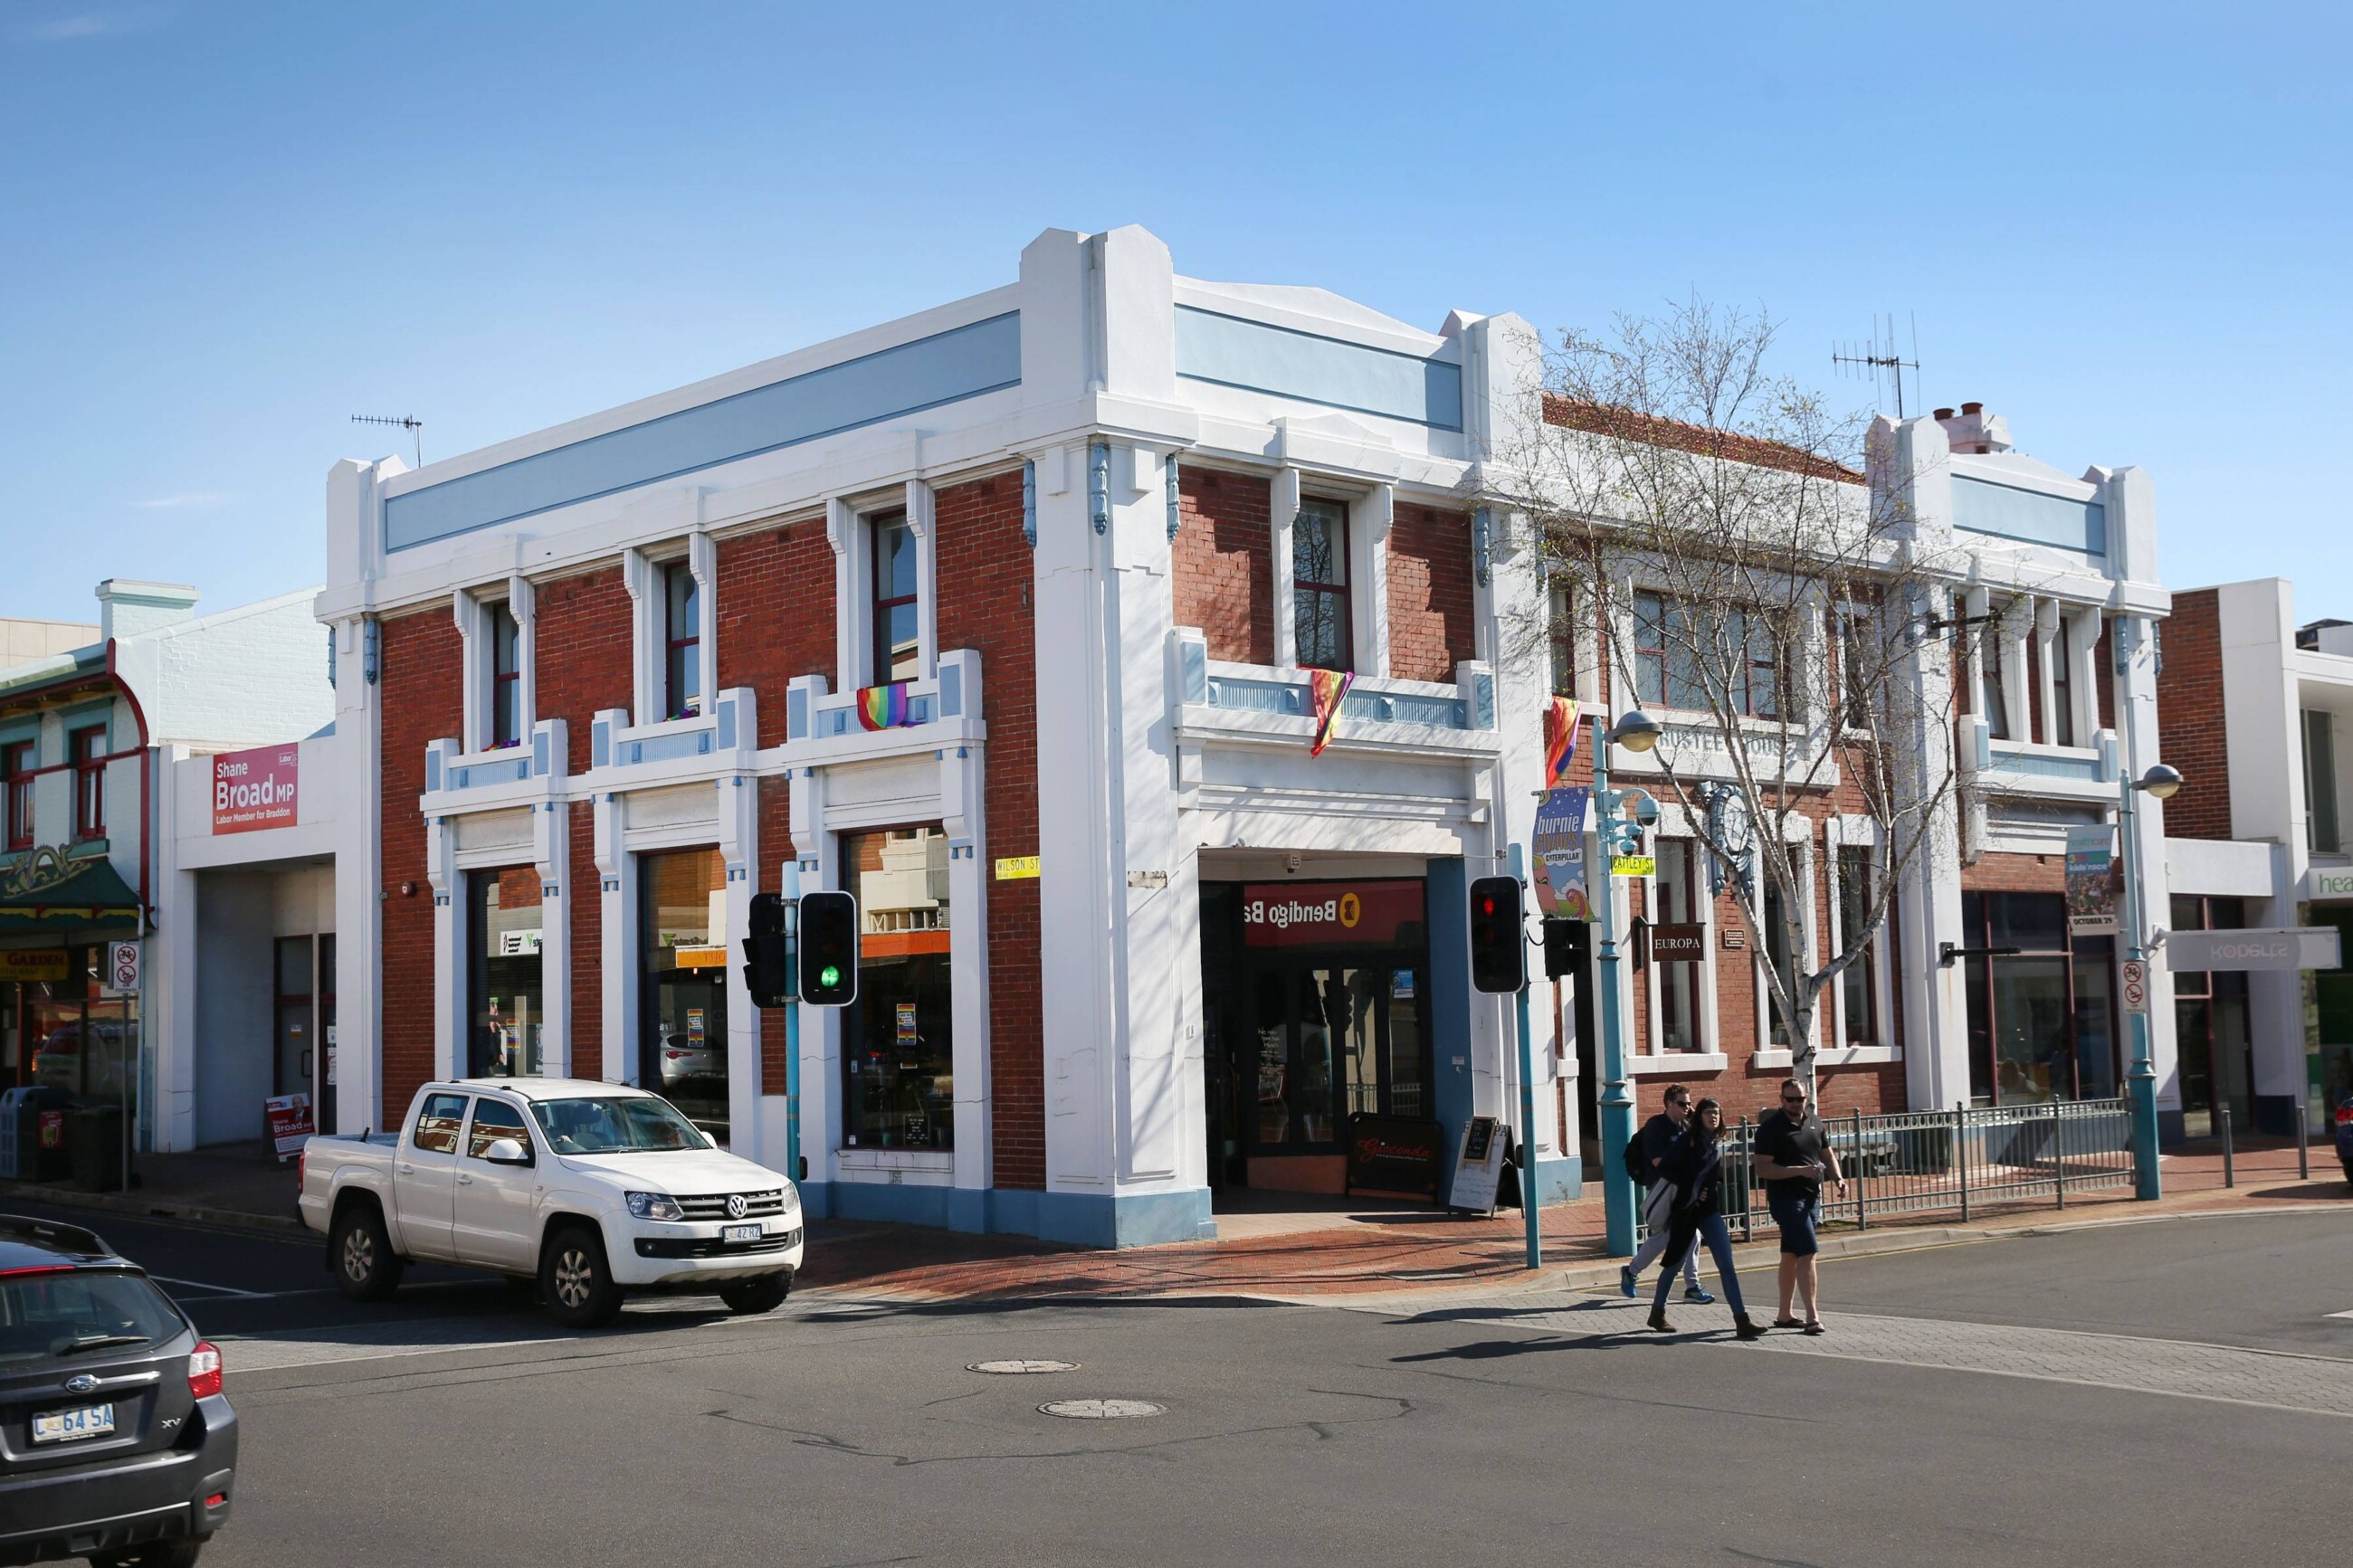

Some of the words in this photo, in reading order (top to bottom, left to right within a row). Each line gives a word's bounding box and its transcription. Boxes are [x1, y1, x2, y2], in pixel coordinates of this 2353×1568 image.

[1655, 728, 1723, 752] RUSTEE
[217, 762, 248, 778] Shane
[216, 774, 273, 811] Broad
[276, 784, 294, 803] MP
[216, 816, 232, 824] Labor
[233, 812, 255, 822] Member
[266, 808, 290, 818] Braddon
[1538, 815, 1579, 834] burnie
[1545, 852, 1580, 862] CATERPILLAR
[1613, 857, 1642, 870] CATTLEY
[996, 859, 1025, 871] WILSON
[1030, 858, 1039, 870] ST
[2319, 874, 2353, 893] hea
[2073, 917, 2101, 926] OCTOBER
[1654, 938, 1700, 949] EUROPA
[7, 952, 64, 965] GARDEN
[273, 1121, 303, 1134] Broad
[1358, 1139, 1432, 1163] Gioconda
[737, 1228, 747, 1239] 42
[749, 1226, 760, 1238] RZ
[63, 1409, 85, 1431] 64
[90, 1404, 113, 1427] SA
[161, 1418, 181, 1429] XV
